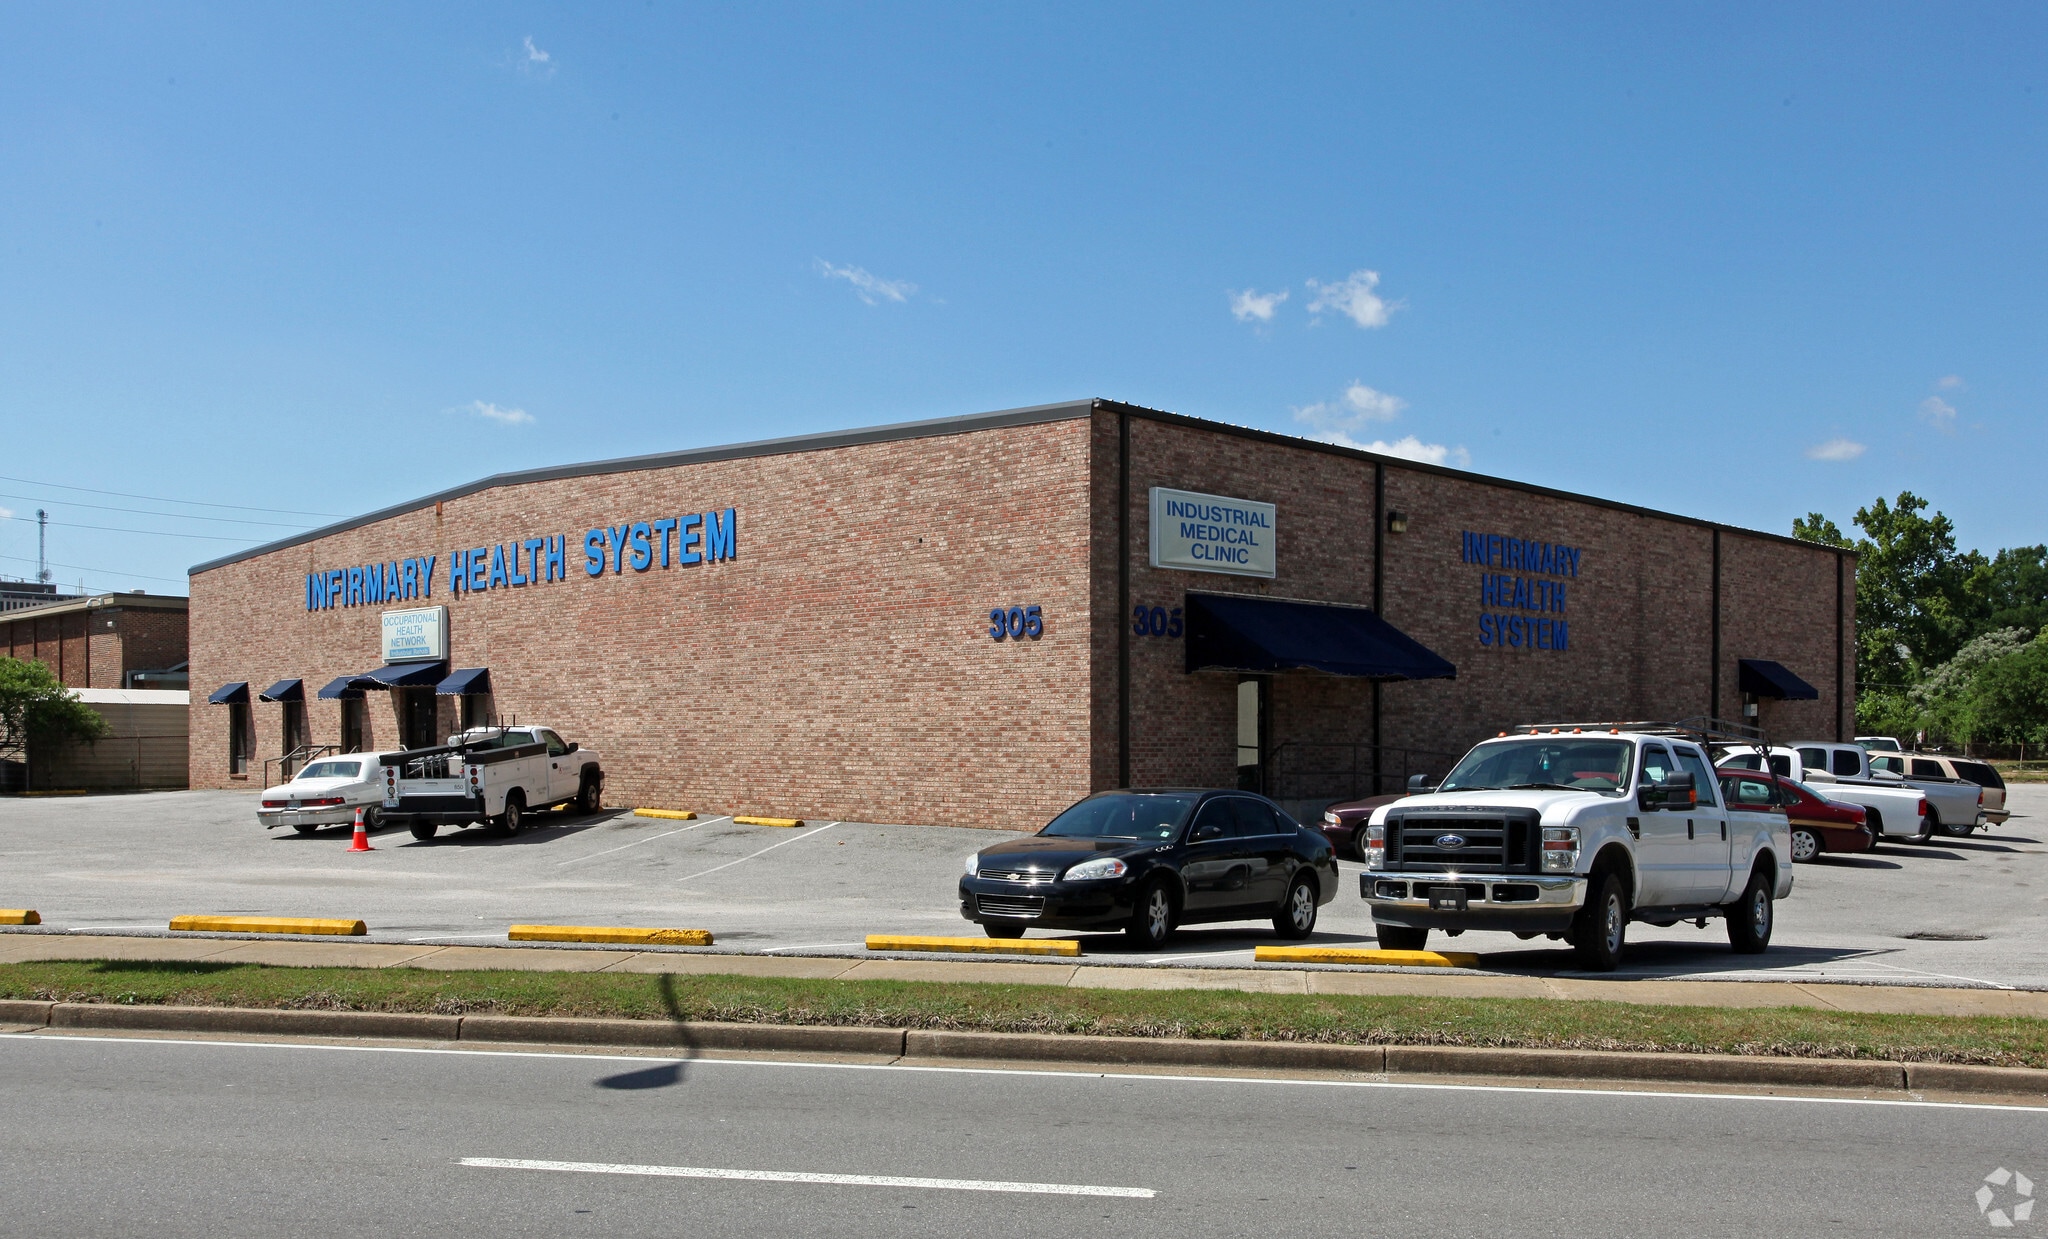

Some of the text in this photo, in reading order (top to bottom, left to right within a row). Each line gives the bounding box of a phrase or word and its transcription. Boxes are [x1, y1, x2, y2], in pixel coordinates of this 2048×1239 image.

[1166, 500, 1270, 528] INDUSTRIAL
[1180, 522, 1259, 546] MEDICAL
[306, 508, 737, 610] INFIRMARY HEALTH SYSTEM
[1191, 543, 1249, 564] CLINIC
[1463, 530, 1581, 577] INFIRMARY
[1482, 573, 1566, 613] HEALTH
[384, 613, 437, 626] OCCUPATIONAL
[396, 625, 423, 636] HEALTH
[989, 605, 1042, 638] 305
[1133, 605, 1184, 638] 305
[1479, 612, 1568, 651] SYSTEM
[391, 636, 427, 648] NETWORK
